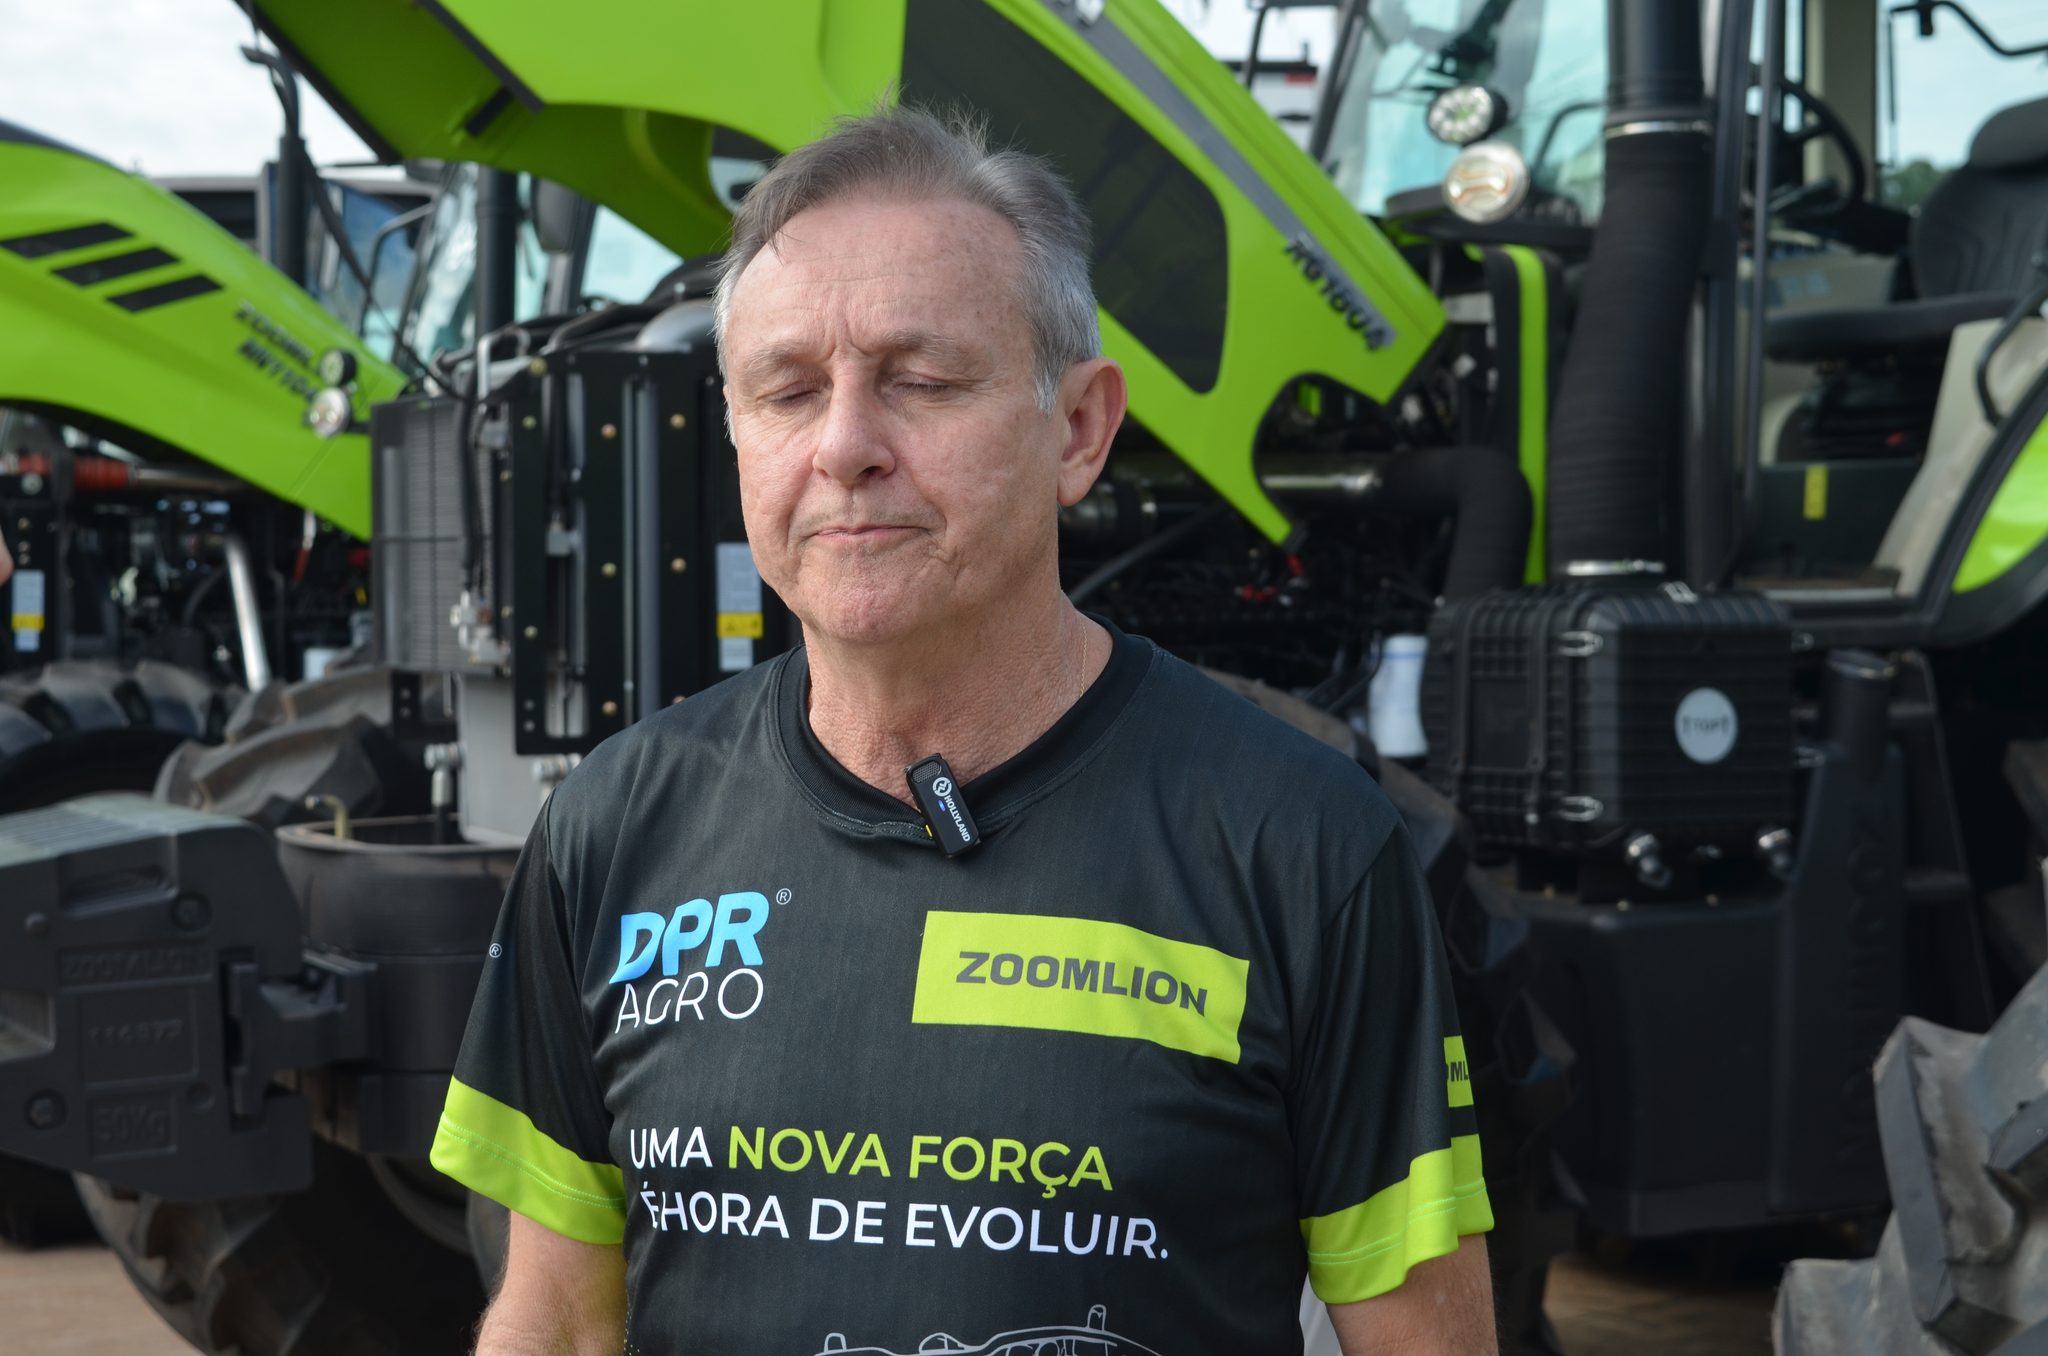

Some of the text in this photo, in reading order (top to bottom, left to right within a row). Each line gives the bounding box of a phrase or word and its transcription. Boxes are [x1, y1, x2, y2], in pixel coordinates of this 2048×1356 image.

[943, 795, 971, 842] HOLLYLAND
[609, 891, 769, 985] DPR
[615, 968, 764, 1034] AGRO
[955, 951, 1208, 1017] ZOOMLION
[630, 1125, 1113, 1199] UMA NOVA FORÇA
[808, 1197, 887, 1244] DE
[905, 1203, 1168, 1259] EVOLUIR.
